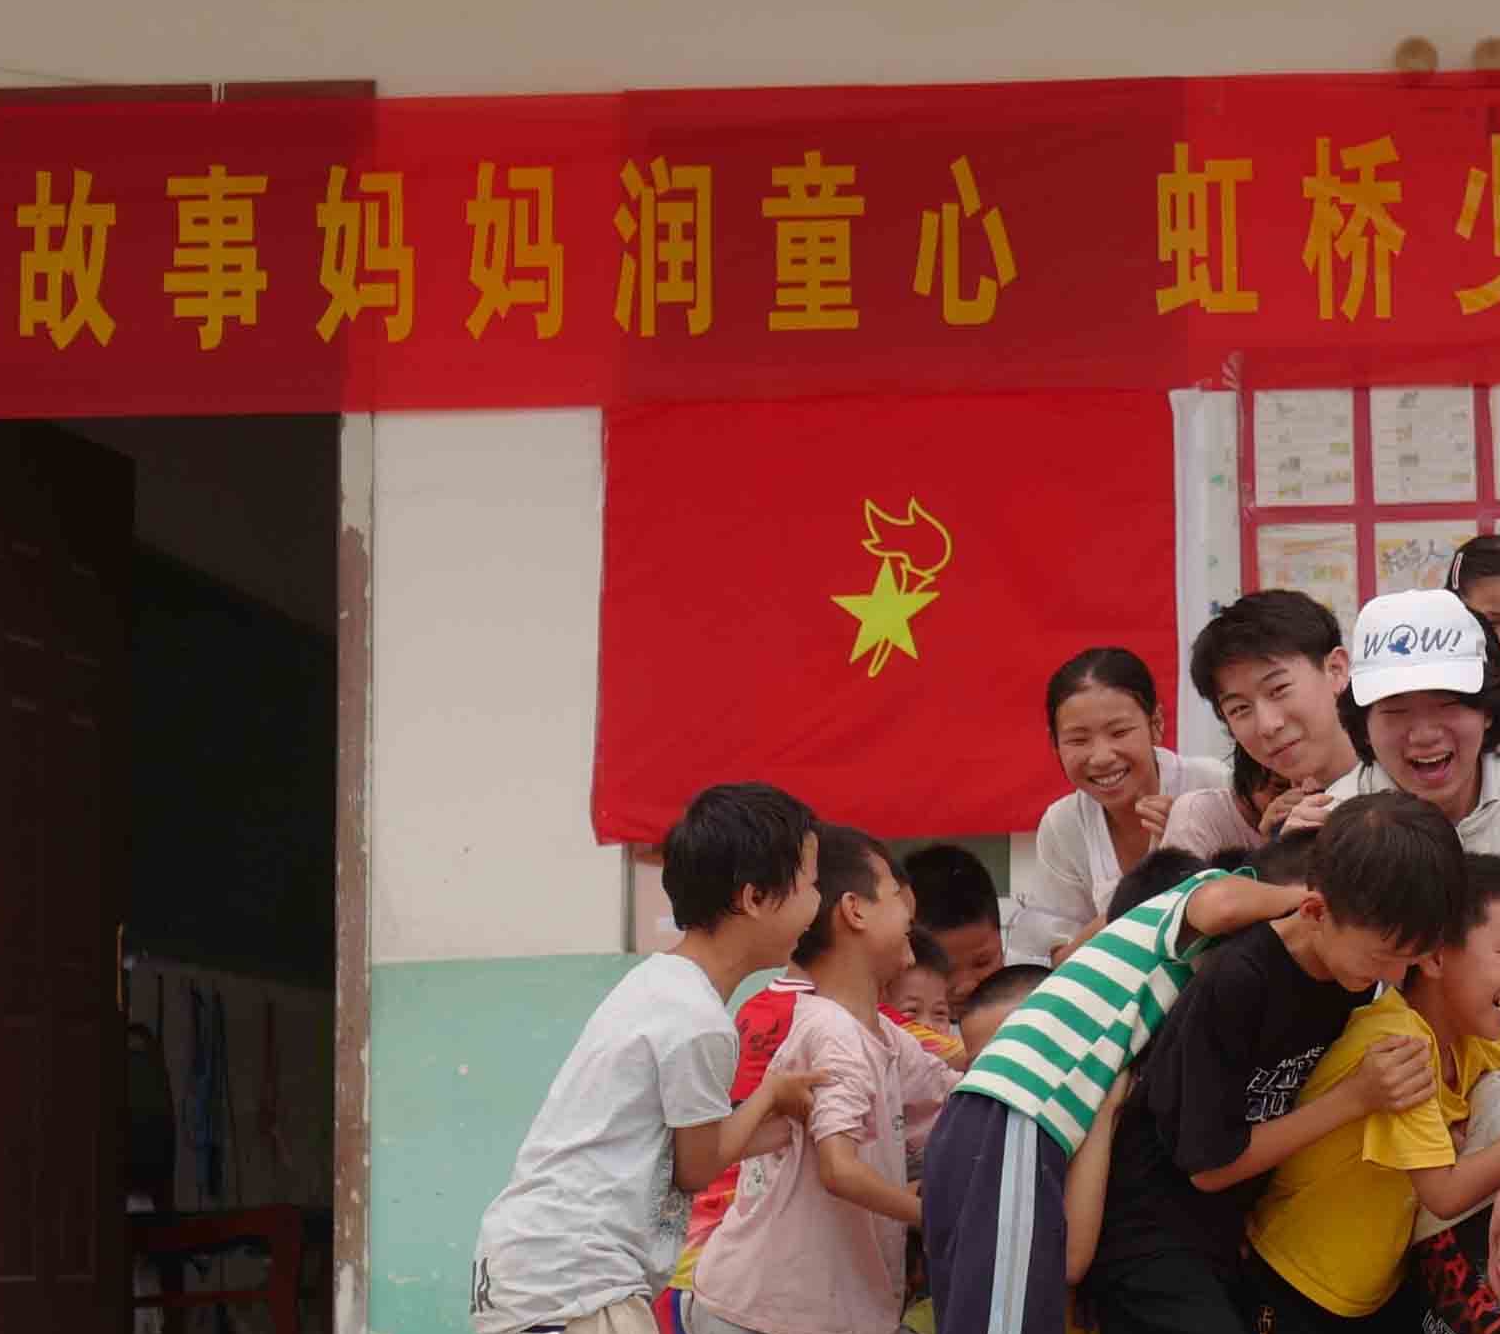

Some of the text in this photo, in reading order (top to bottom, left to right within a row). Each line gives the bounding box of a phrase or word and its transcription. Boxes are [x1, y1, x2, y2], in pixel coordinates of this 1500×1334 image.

[15, 149, 1018, 351] 故事妈妈润童心
